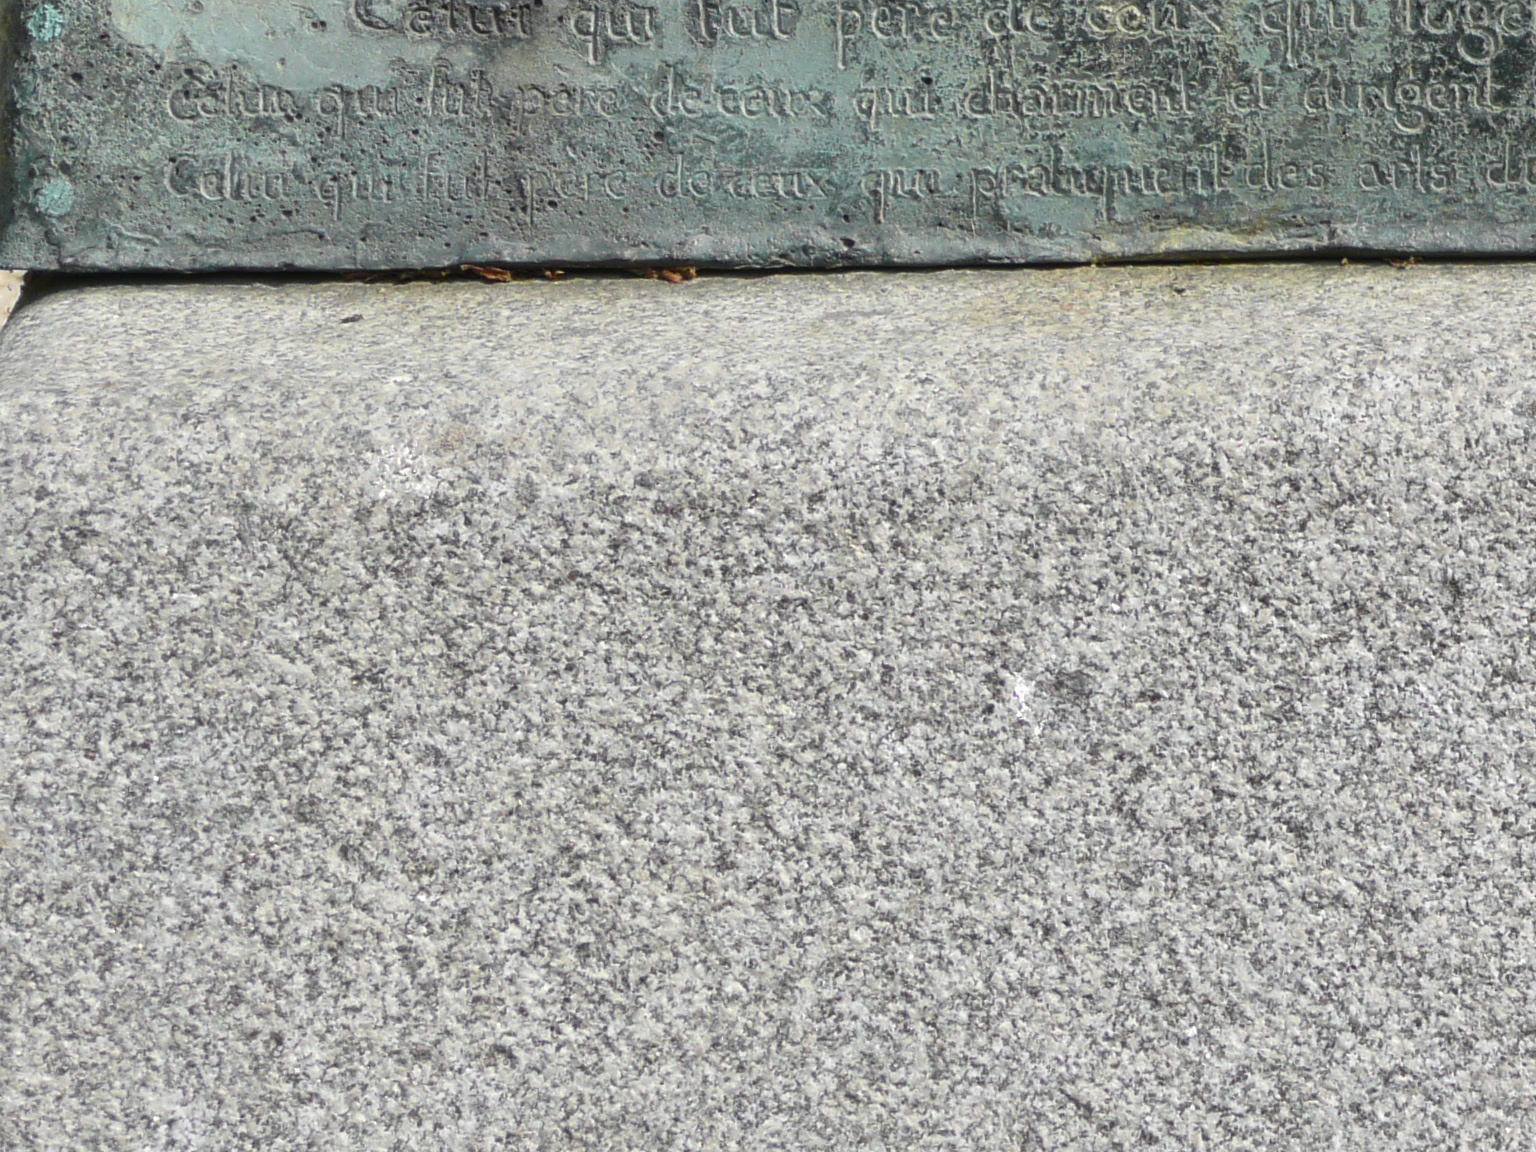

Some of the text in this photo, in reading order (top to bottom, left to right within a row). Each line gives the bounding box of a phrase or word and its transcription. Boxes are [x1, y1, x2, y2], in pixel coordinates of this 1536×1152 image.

[570, 1, 655, 65] qui
[1086, 0, 1224, 38] ceux
[854, 84, 936, 132] qui
